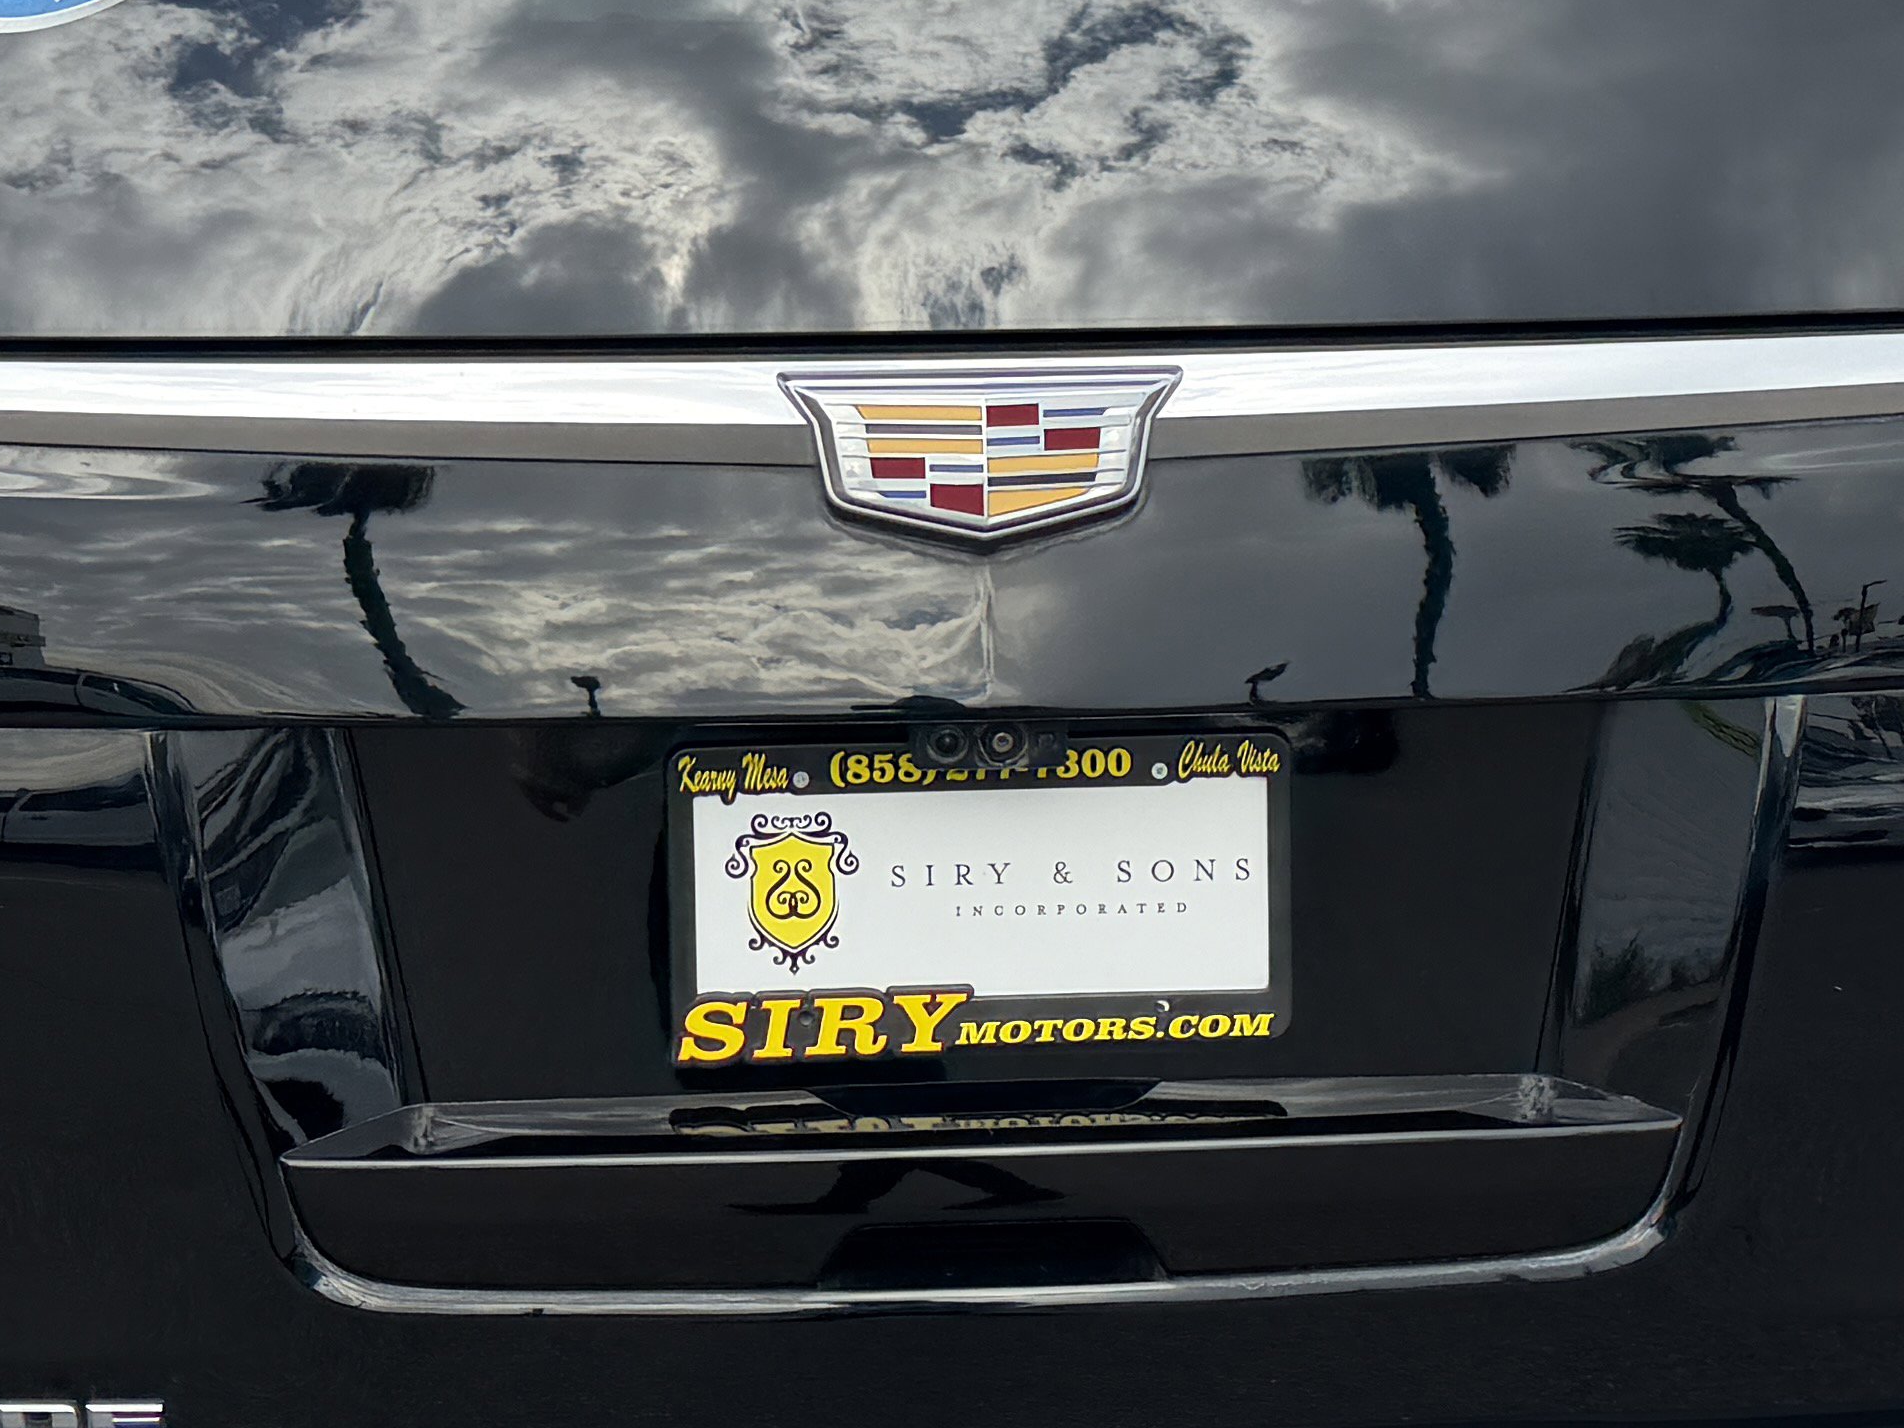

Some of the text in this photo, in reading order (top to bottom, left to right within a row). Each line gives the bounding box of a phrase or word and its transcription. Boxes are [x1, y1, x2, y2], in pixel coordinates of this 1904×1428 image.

[1177, 740, 1281, 779] Chula Vista
[677, 752, 789, 804] Kearny Mesa
[890, 858, 1252, 889] SIRY & SONS
[954, 901, 1189, 918] INCORPORATED
